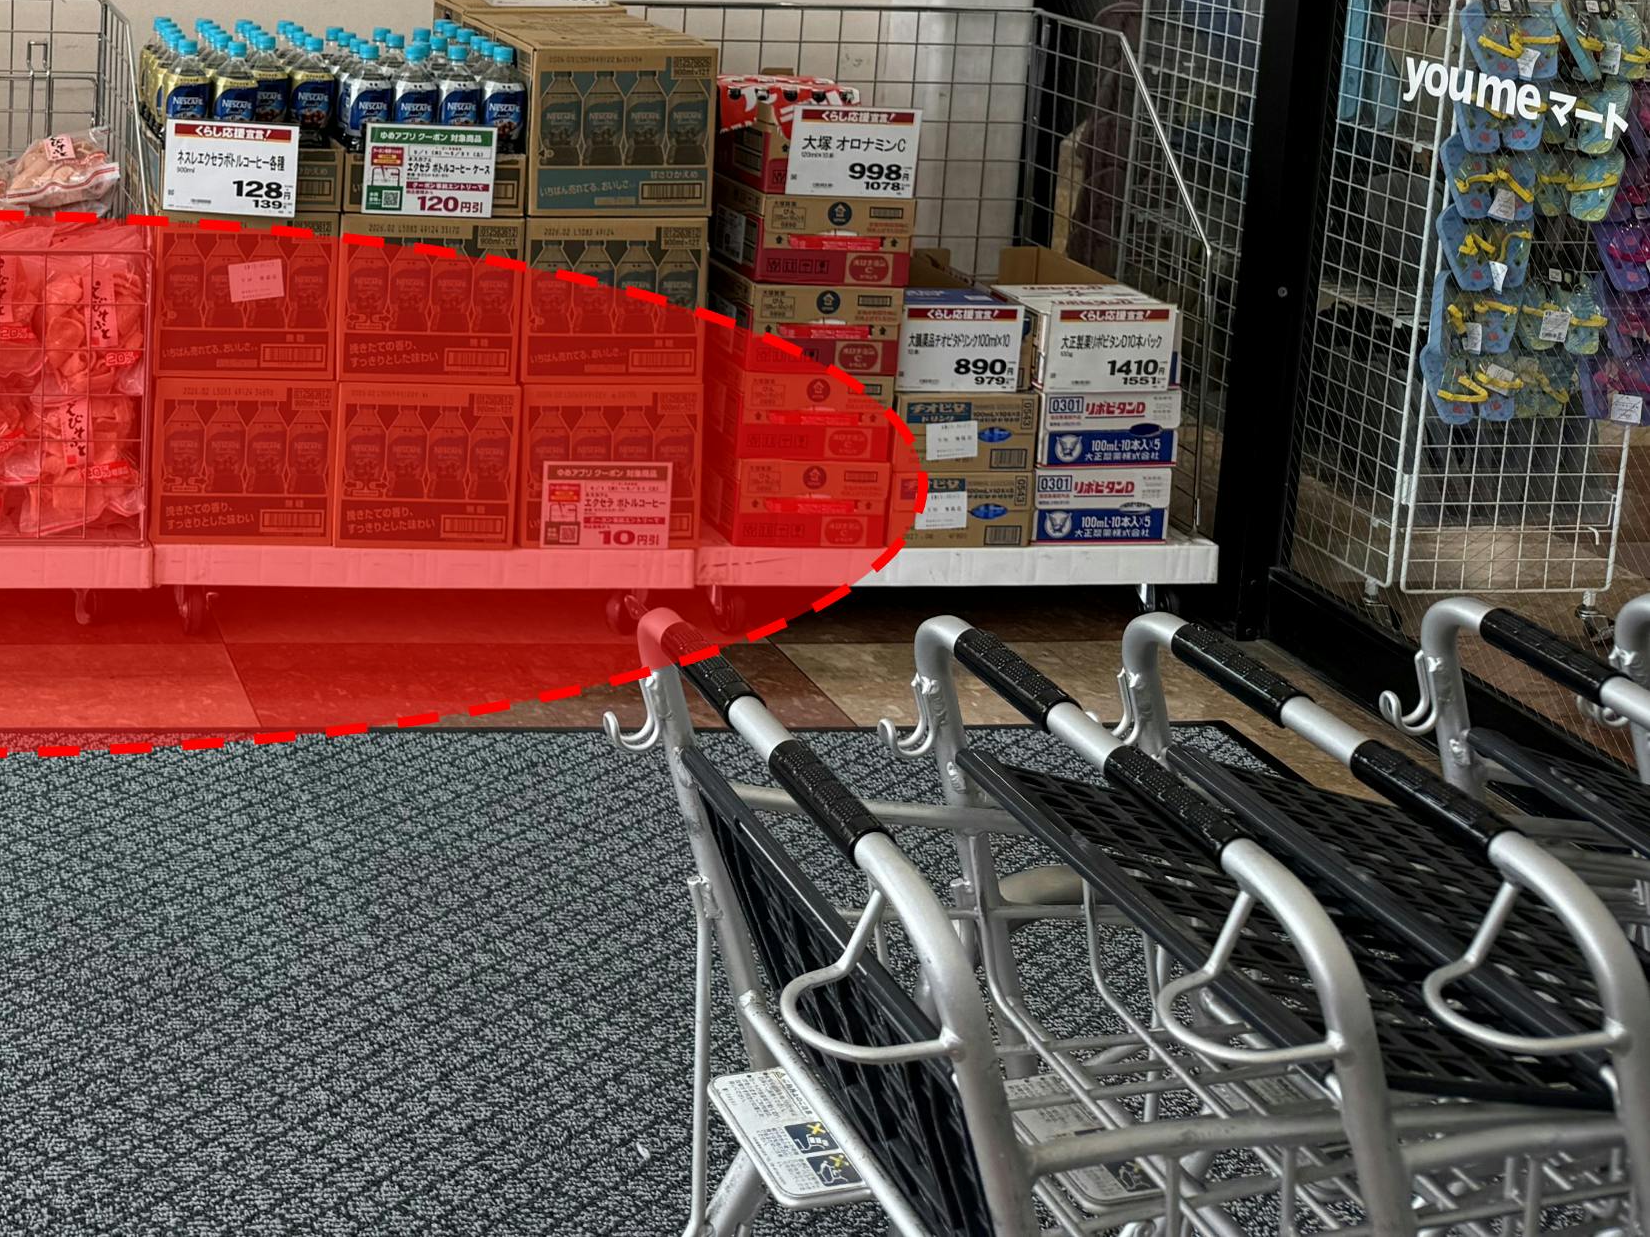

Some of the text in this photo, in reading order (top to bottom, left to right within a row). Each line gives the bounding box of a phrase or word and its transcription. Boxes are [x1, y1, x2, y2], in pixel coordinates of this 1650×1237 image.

[1402, 56, 1629, 140] youme マート
[380, 132, 418, 141] ゆめアプリ
[418, 133, 448, 143] クーポン
[801, 135, 907, 153] 大塚 オロナミンC
[407, 162, 491, 175] エクセラ ボトルコーヒー ケース
[848, 162, 903, 182] 998
[232, 180, 284, 200] 128
[863, 181, 901, 192] 1078
[252, 199, 283, 210] 139
[417, 196, 483, 214] 120 円引
[954, 358, 1007, 376] 890
[1107, 359, 1159, 376] 1410
[974, 376, 1006, 386] 979
[1122, 376, 1157, 386] 1551
[1052, 398, 1081, 413] 0301
[1085, 401, 1147, 416] リポビタンD
[1040, 477, 1070, 491] 0301
[1074, 480, 1135, 494] リポビタンD
[584, 497, 668, 508] エクセラ ボトルコーヒー
[598, 529, 660, 546] 10 円引
